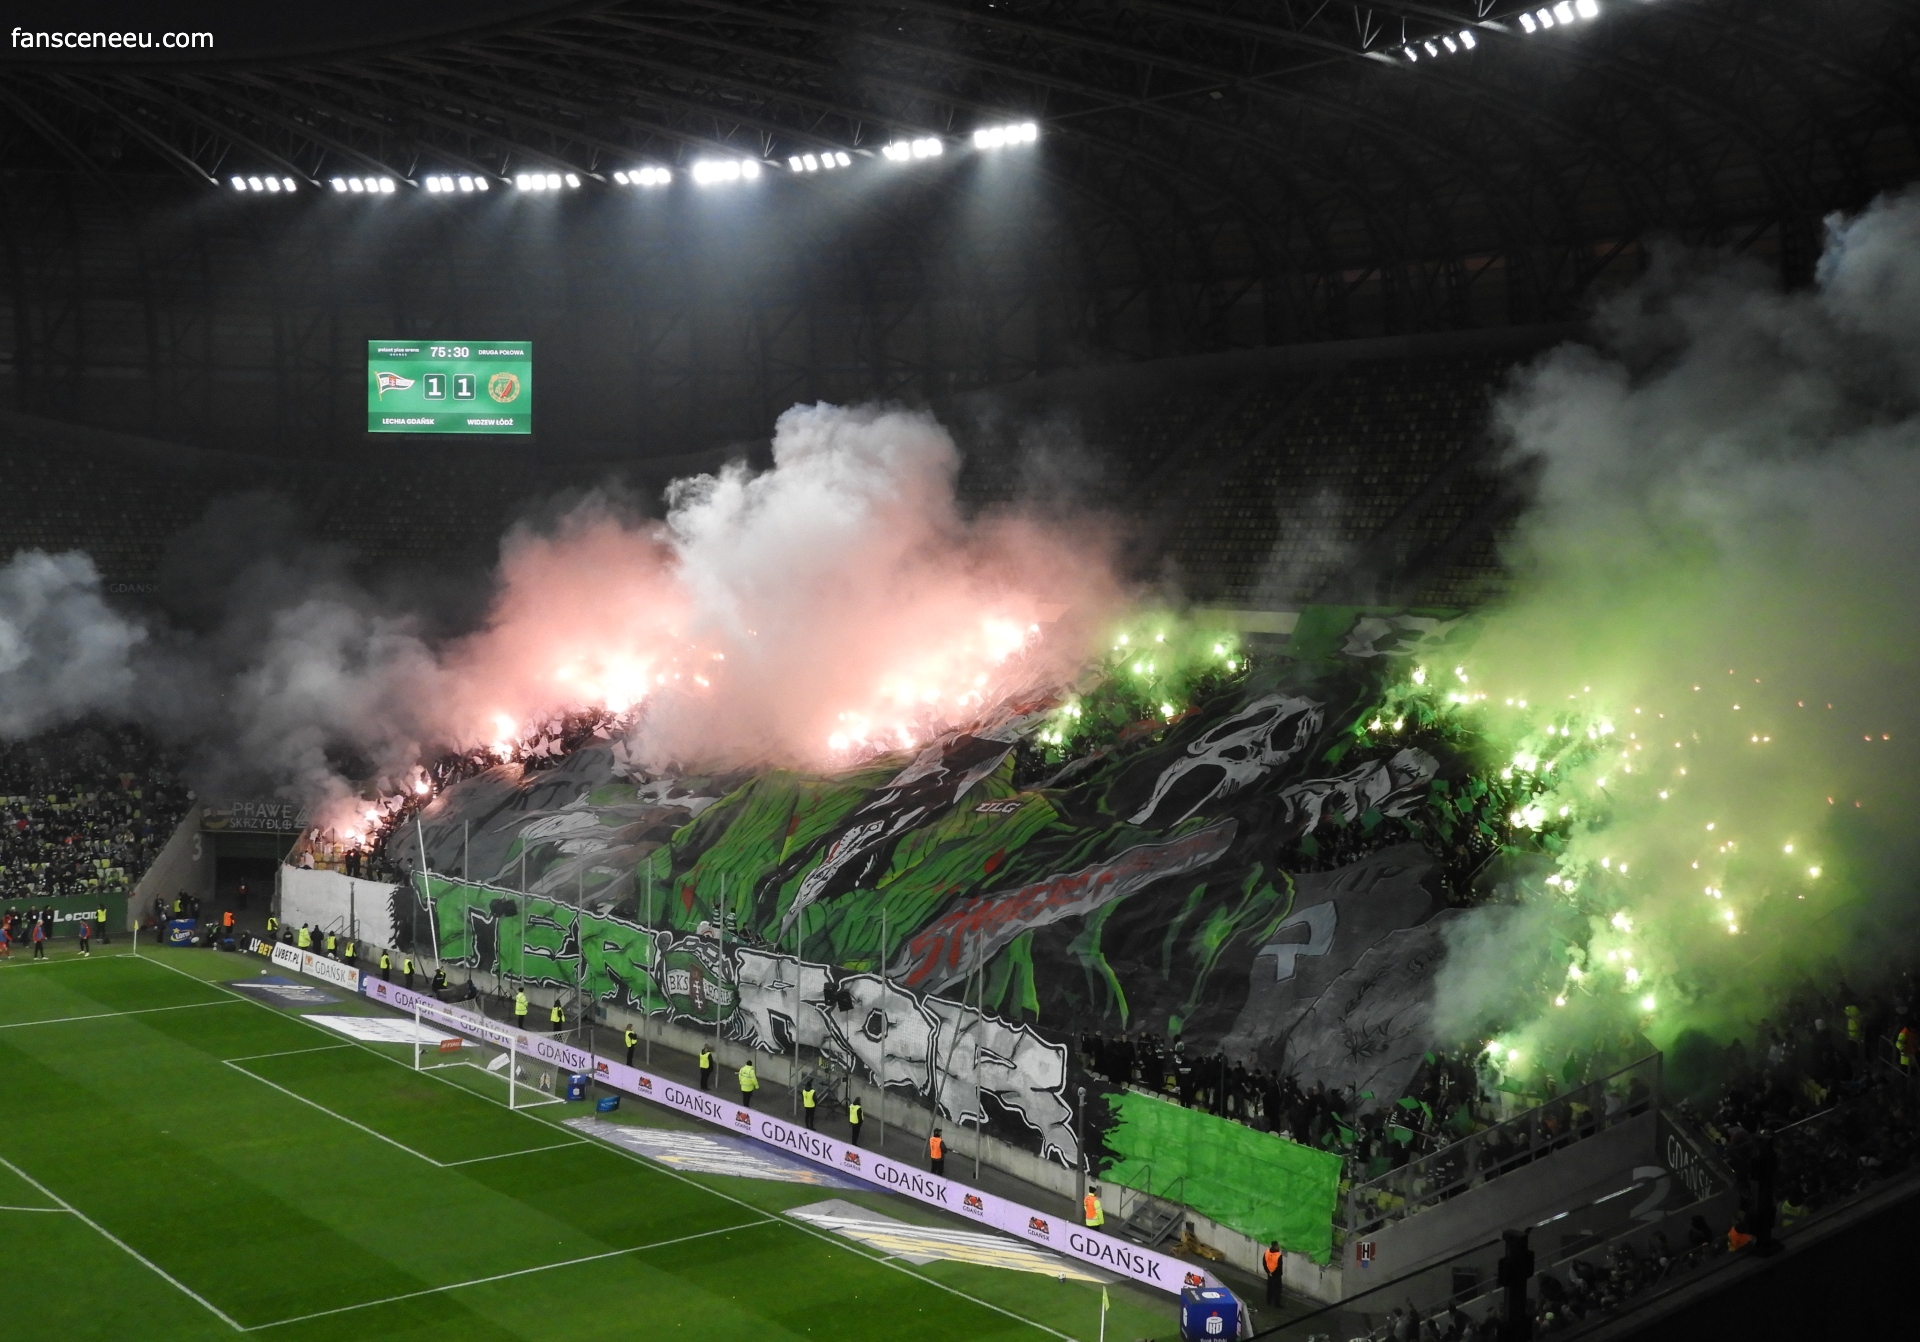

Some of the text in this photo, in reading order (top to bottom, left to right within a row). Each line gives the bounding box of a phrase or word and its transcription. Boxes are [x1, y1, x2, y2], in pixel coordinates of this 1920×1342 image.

[428, 377, 441, 396] 1
[458, 377, 471, 397] 1
[406, 417, 434, 425] GDAŃSK
[496, 417, 513, 426] ŁÓDŹ
[232, 802, 292, 818] PRAWE
[249, 937, 273, 957] LVBET
[274, 946, 299, 965] LVBET.PL
[315, 960, 346, 982] GDAŃSK
[668, 974, 689, 990] BKS
[537, 1042, 586, 1068] GDAŃSK
[664, 1087, 722, 1120] GDAŃSK
[761, 1121, 833, 1162] GDAŃSK
[874, 1163, 948, 1204] GDAŃSK
[962, 1205, 984, 1218] GDAŃSK
[1027, 1228, 1050, 1242] GDAŃSK
[1069, 1233, 1162, 1282] GDAŃSK
